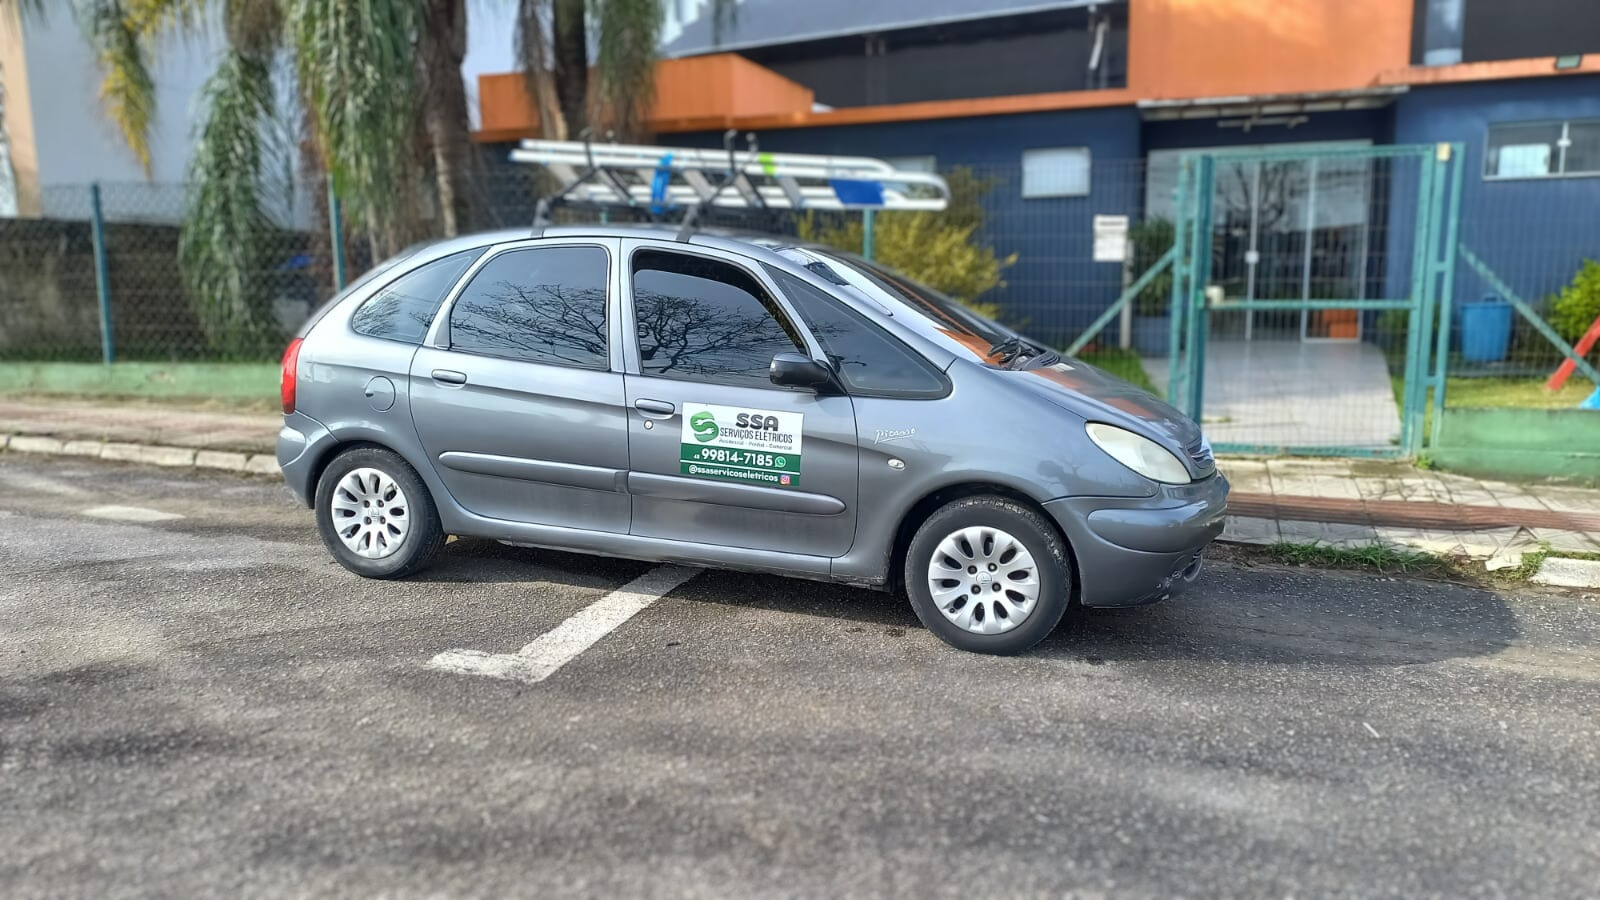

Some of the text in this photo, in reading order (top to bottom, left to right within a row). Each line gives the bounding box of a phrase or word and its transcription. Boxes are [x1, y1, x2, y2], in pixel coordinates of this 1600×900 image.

[736, 413, 779, 431] SSA
[720, 427, 754, 440] SERVIÇOS
[702, 448, 773, 466] 99814-7185
[688, 464, 778, 481] @ssaservicoseletricos
